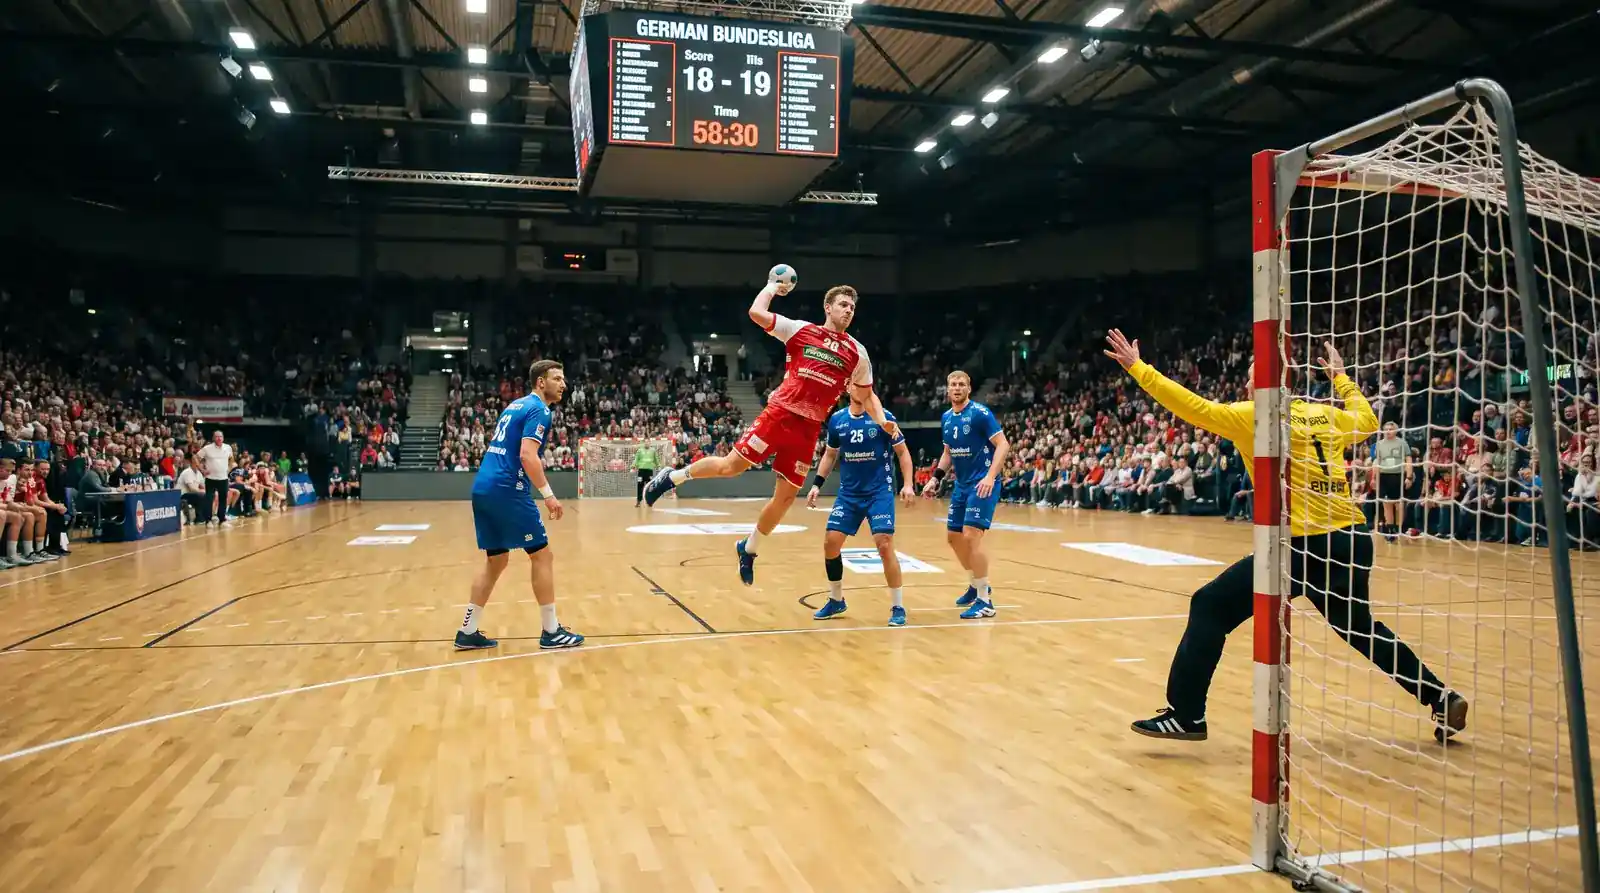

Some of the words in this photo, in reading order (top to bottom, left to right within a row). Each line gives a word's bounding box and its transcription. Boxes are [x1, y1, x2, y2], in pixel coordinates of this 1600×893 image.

[636, 18, 708, 41] GERMAN
[713, 25, 815, 49] BUNDESLIGA
[684, 49, 714, 62] Score
[682, 66, 714, 93] 18
[739, 69, 771, 97] 19
[713, 105, 739, 118] Time
[693, 119, 759, 147] 58:30
[850, 428, 864, 444] 25
[953, 425, 959, 440] 3
